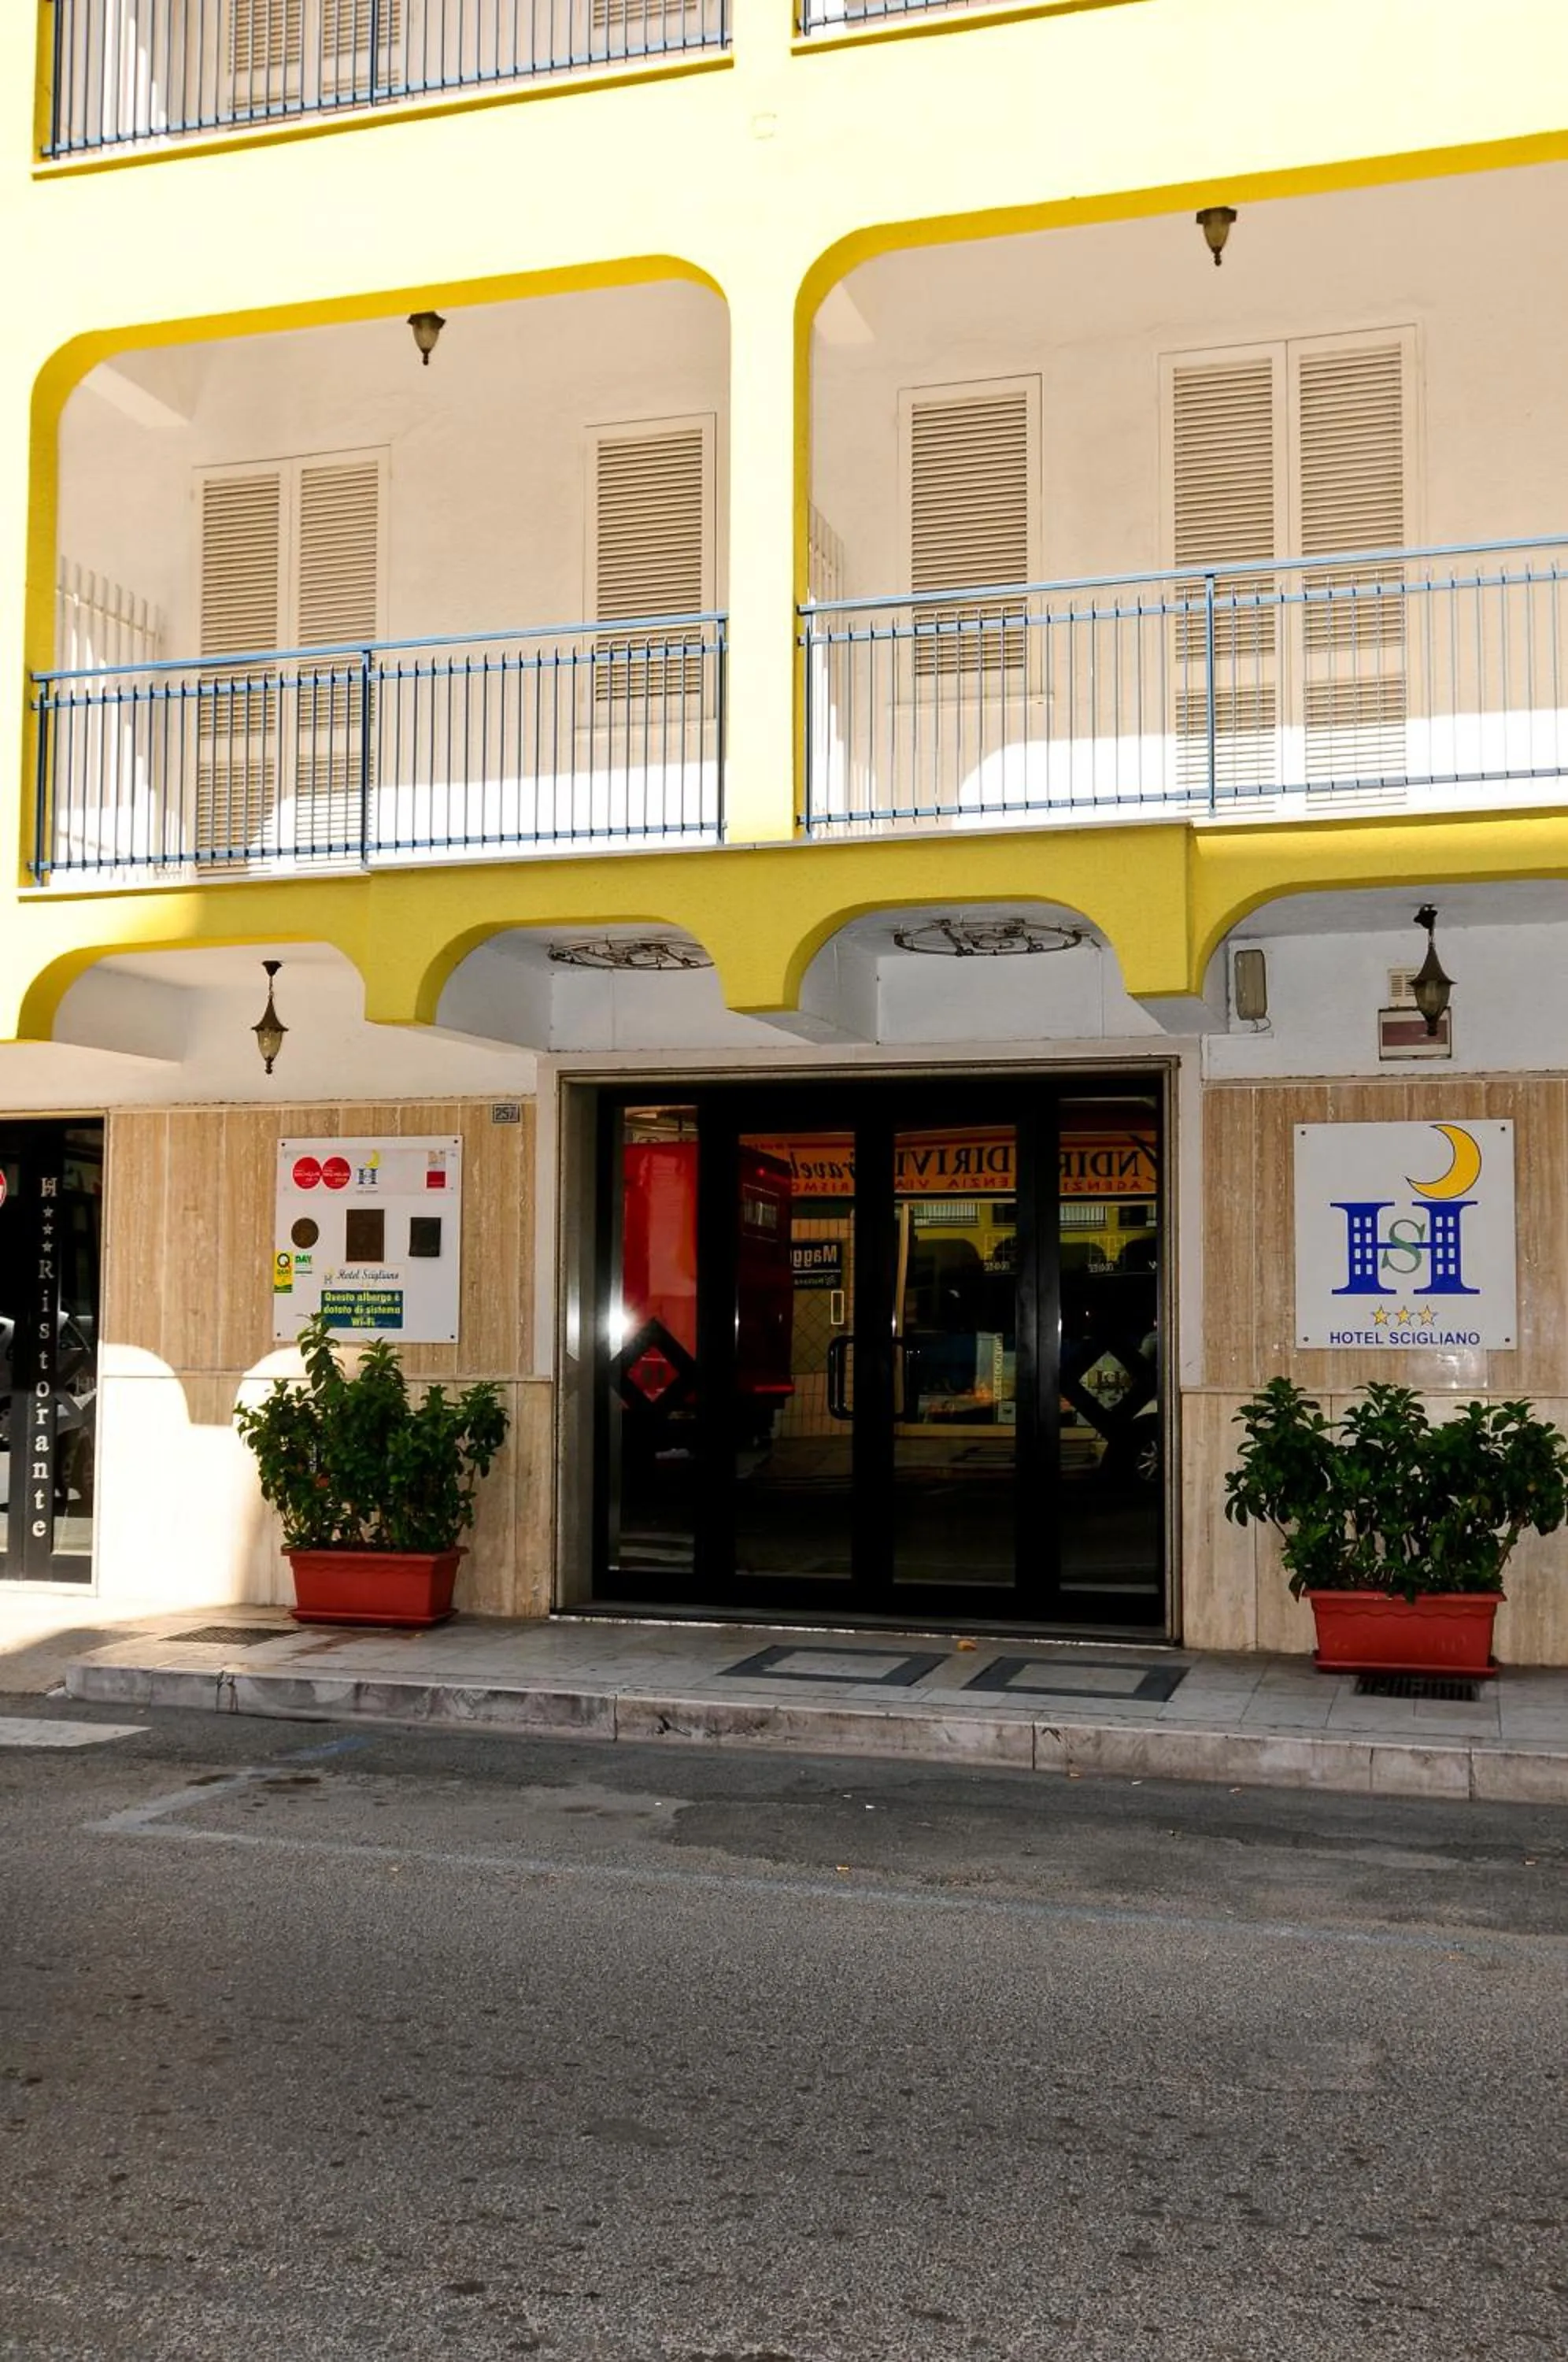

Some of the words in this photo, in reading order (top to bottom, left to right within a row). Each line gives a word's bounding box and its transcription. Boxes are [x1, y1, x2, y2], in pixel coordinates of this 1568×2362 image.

[325, 1292, 354, 1301] Questo
[357, 1292, 391, 1304] albergo
[324, 1305, 351, 1313] dotato
[354, 1305, 363, 1313] di
[367, 1305, 400, 1313] sistema
[1329, 1331, 1384, 1344] HOTEL
[1389, 1331, 1481, 1345] SCIGLIANO
[31, 1260, 54, 1537] Ristorante
